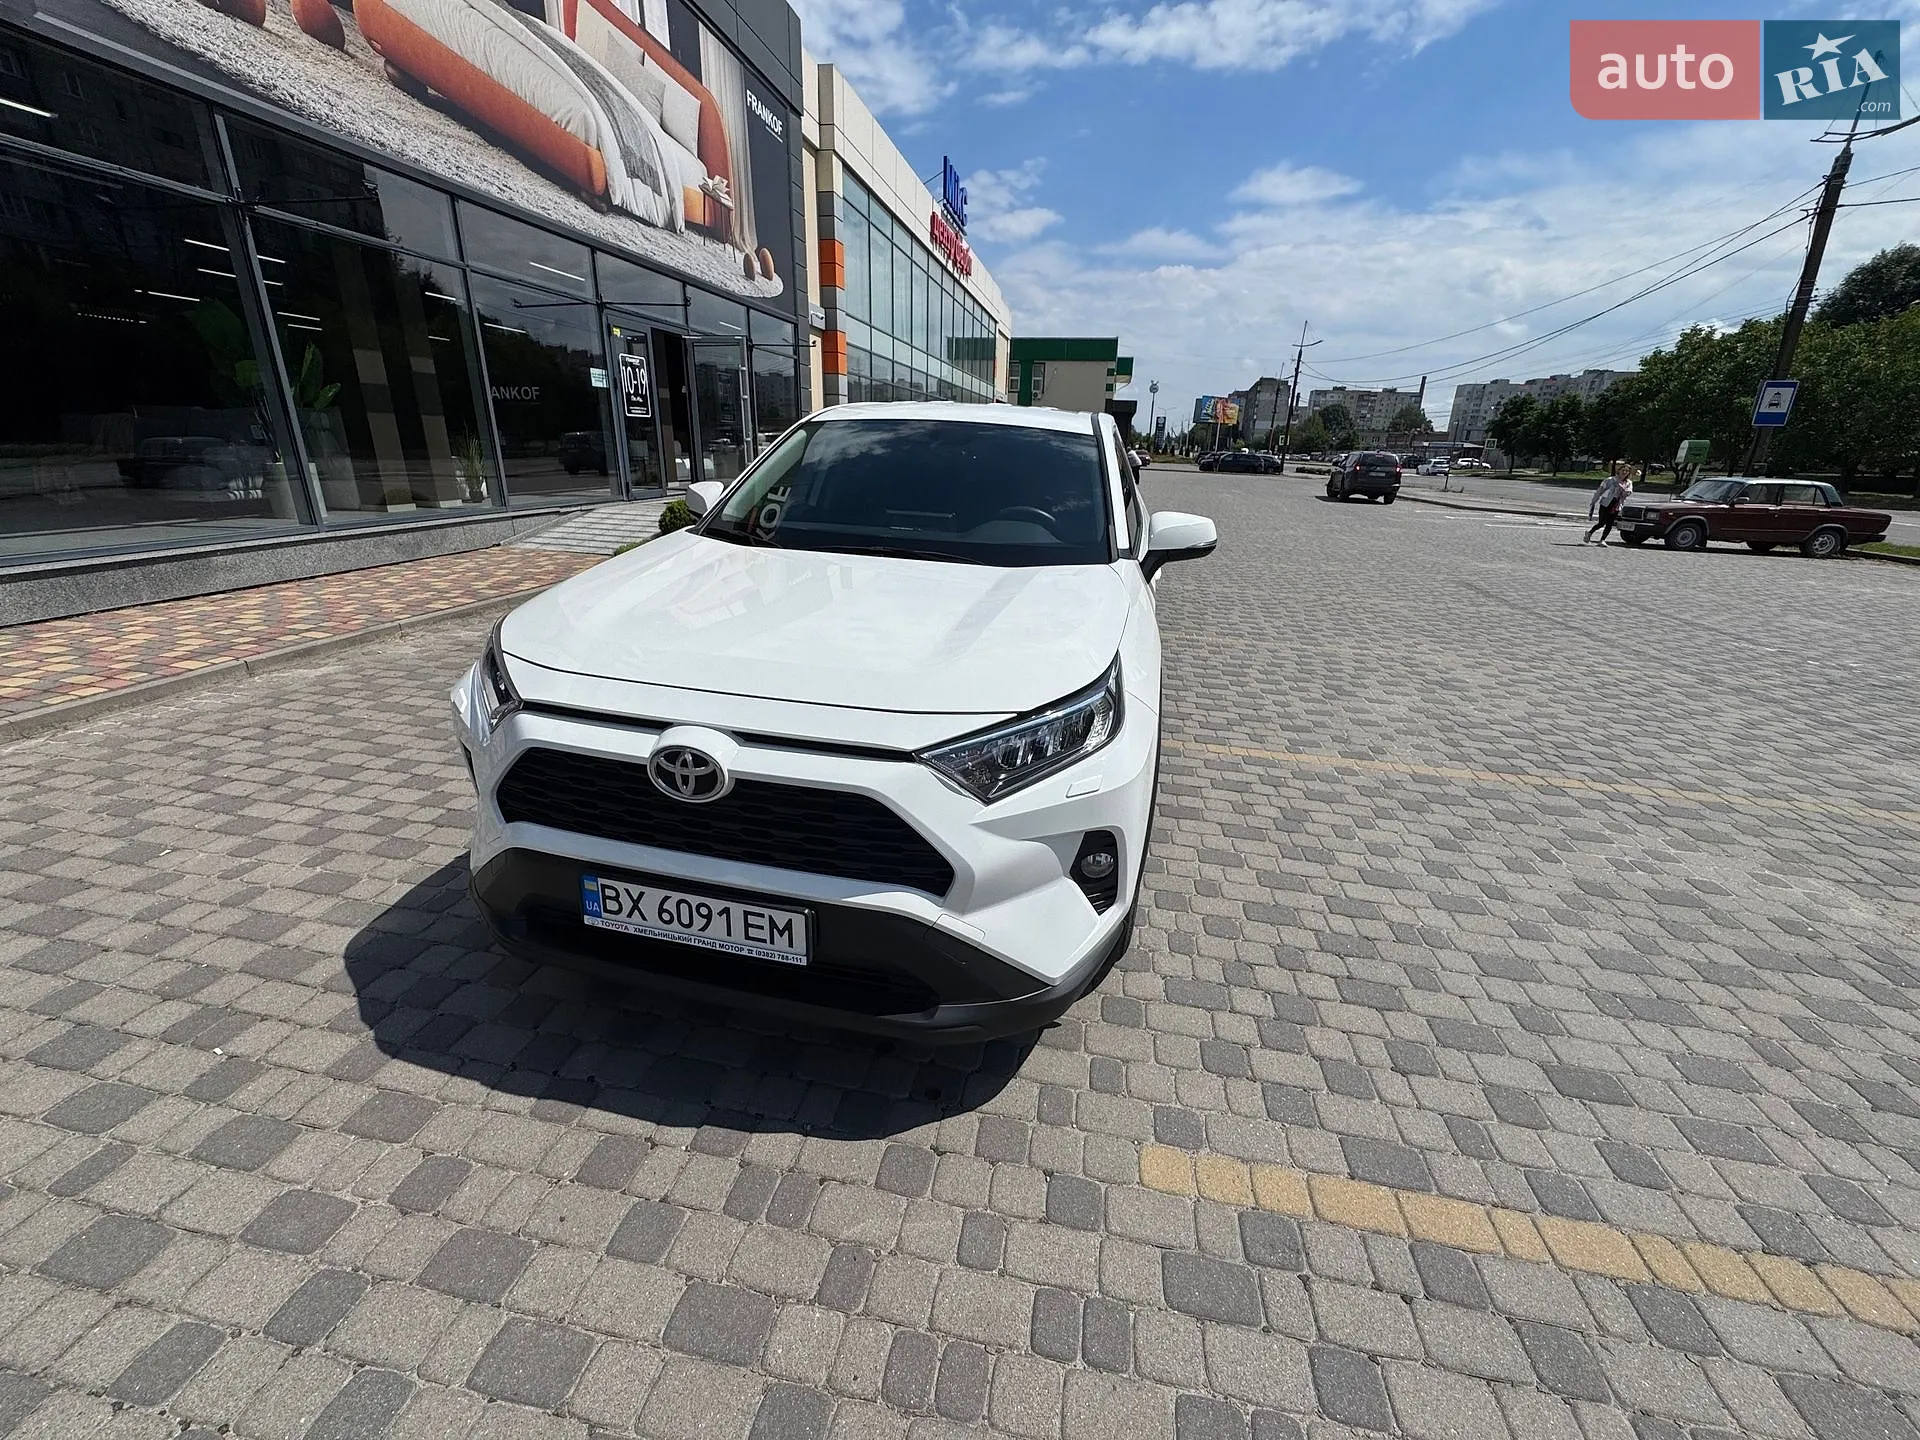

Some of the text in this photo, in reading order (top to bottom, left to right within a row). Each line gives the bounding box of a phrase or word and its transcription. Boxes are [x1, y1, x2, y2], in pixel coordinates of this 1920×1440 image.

[746, 89, 783, 136] FRANKOF
[622, 365, 647, 396] 10-19
[585, 900, 600, 913] UA
[600, 882, 794, 949] BX 6091 EM
[600, 920, 630, 932] TOYOTA
[693, 937, 717, 949] ГРАНД
[718, 942, 745, 954] МОТОР
